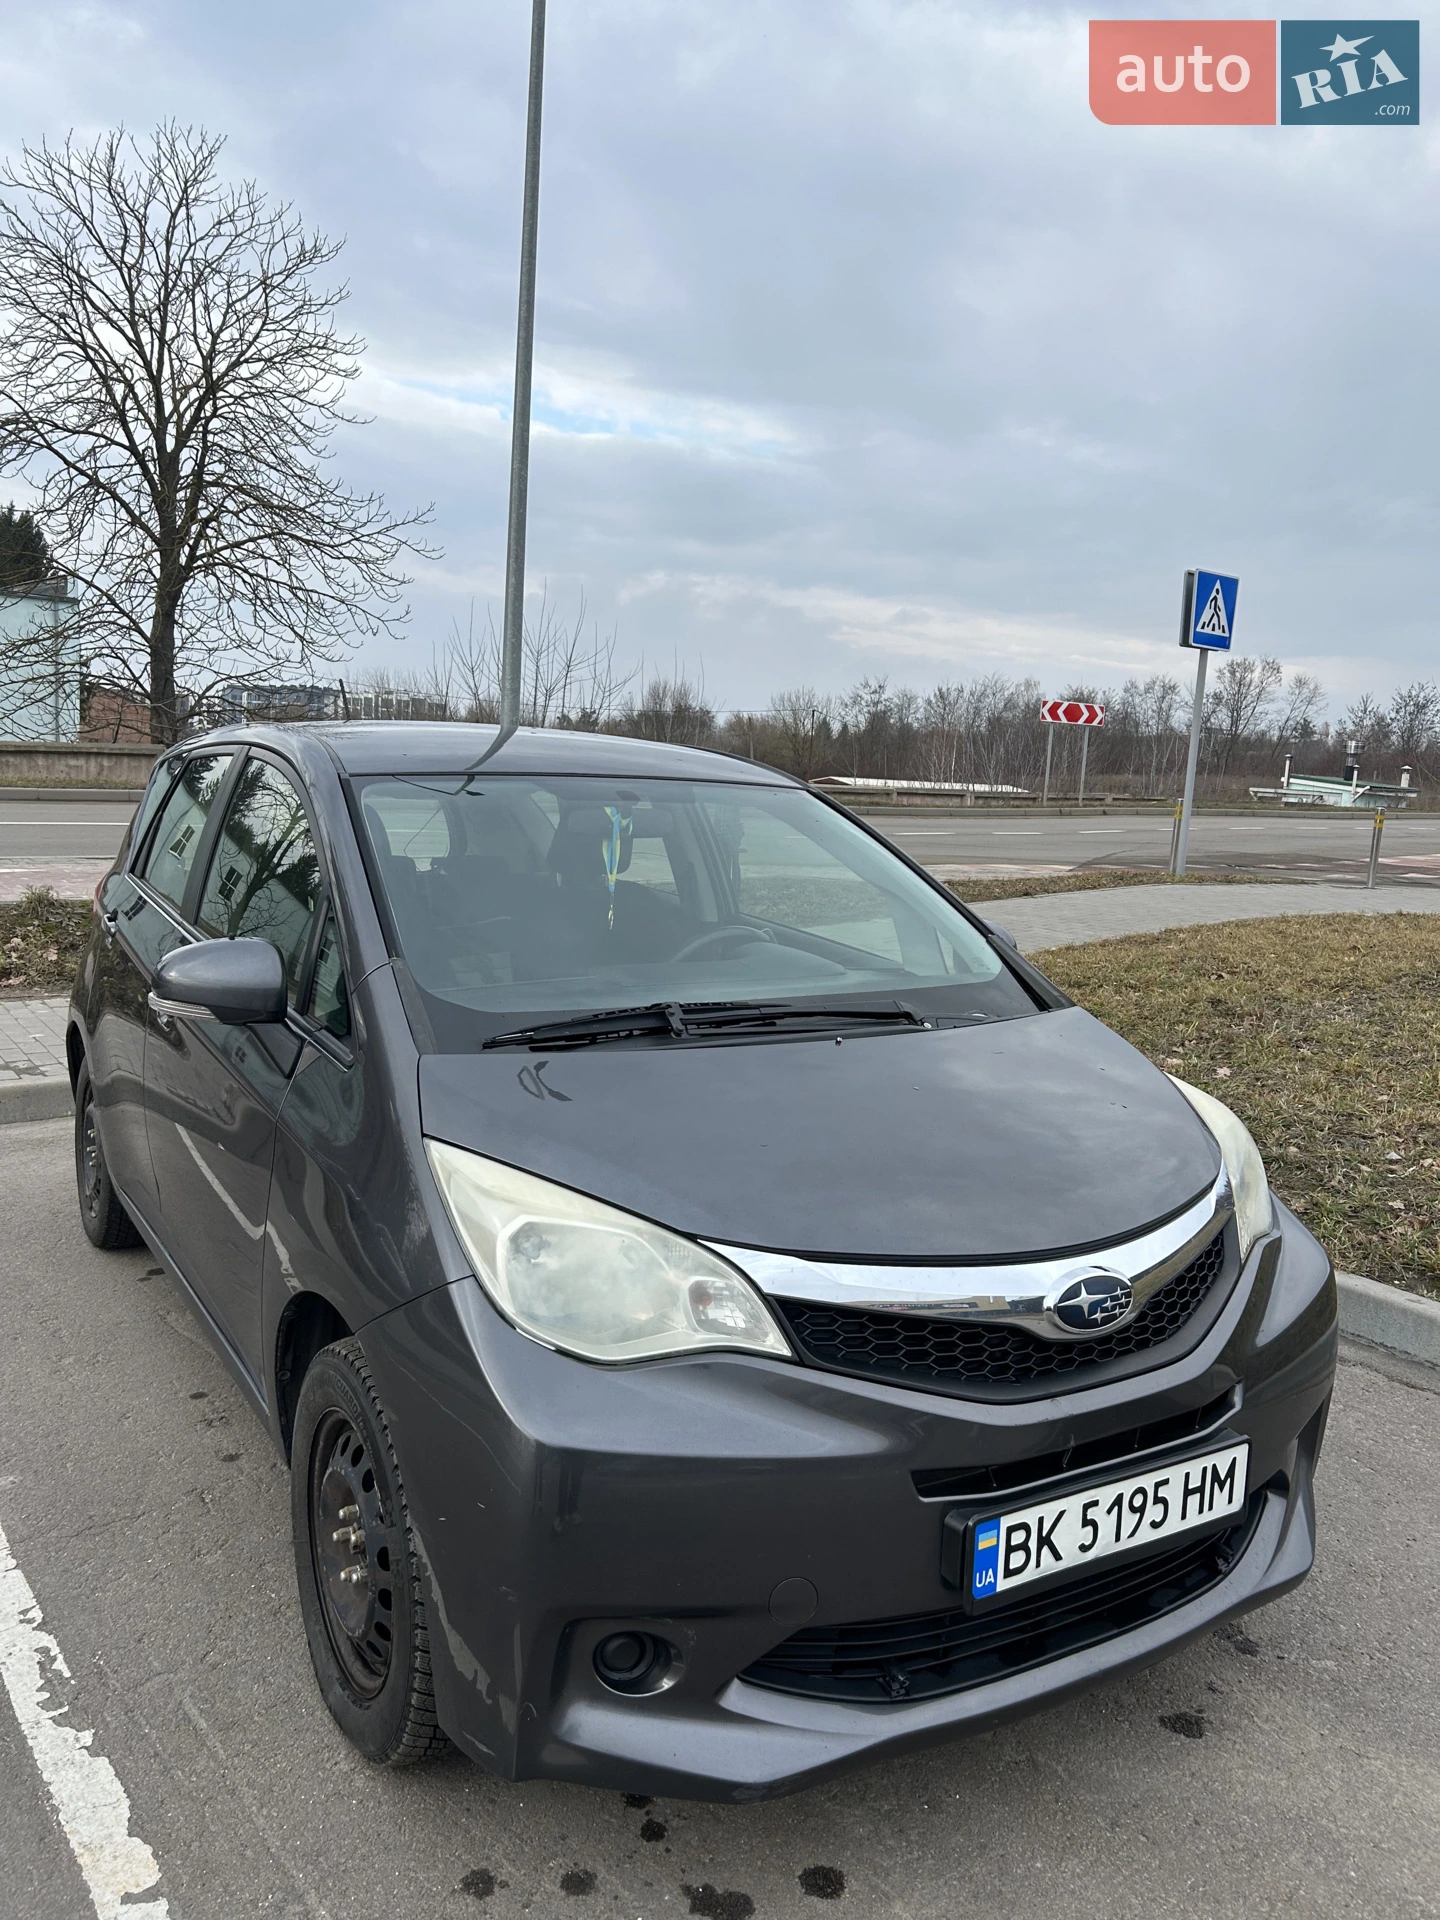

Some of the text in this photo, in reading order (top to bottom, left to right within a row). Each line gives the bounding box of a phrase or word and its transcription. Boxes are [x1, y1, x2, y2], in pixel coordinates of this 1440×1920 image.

[1003, 1456, 1237, 1580] BK 5195 HM
[975, 1568, 995, 1588] UA
